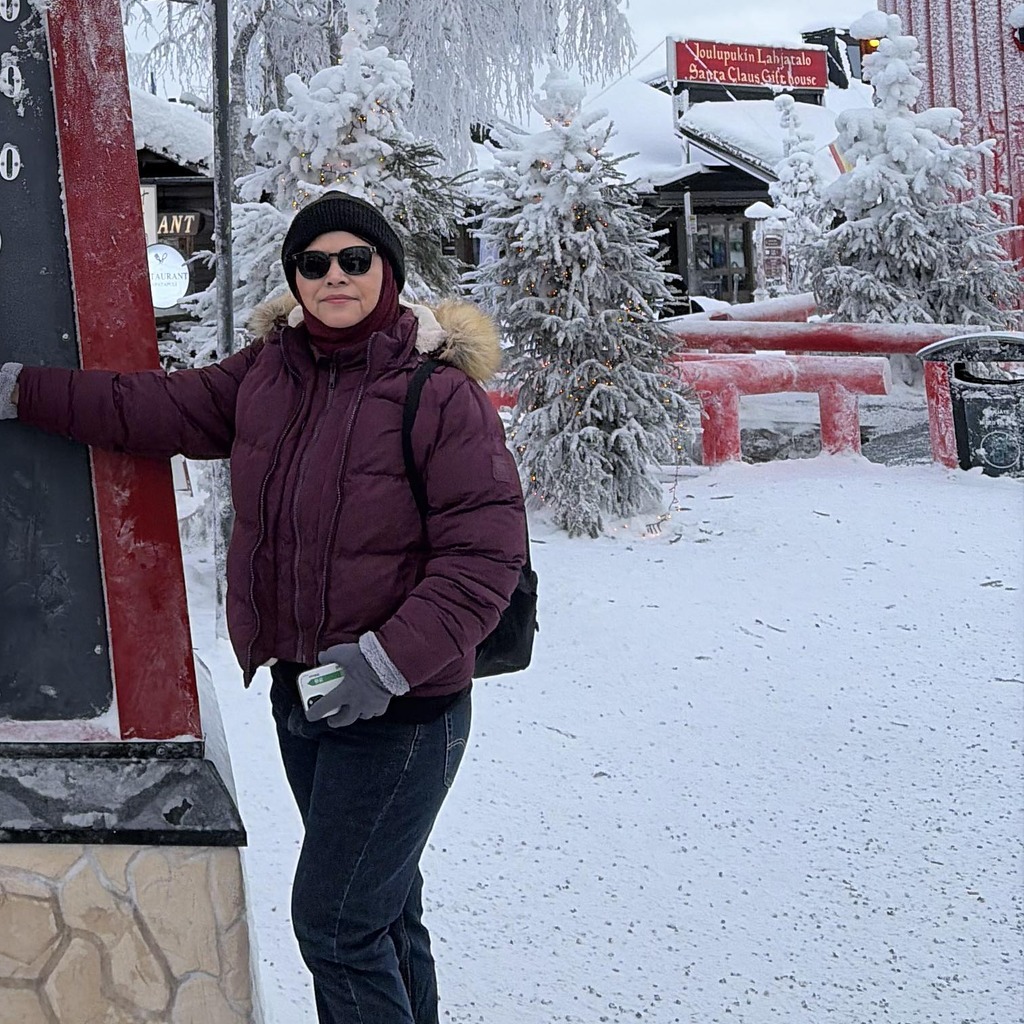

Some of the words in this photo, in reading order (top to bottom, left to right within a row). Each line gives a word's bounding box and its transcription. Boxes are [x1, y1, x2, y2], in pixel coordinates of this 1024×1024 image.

[693, 42, 755, 66] Joulupukin
[689, 63, 726, 82] Santa
[727, 66, 760, 83] Claus
[157, 215, 195, 234] ANT
